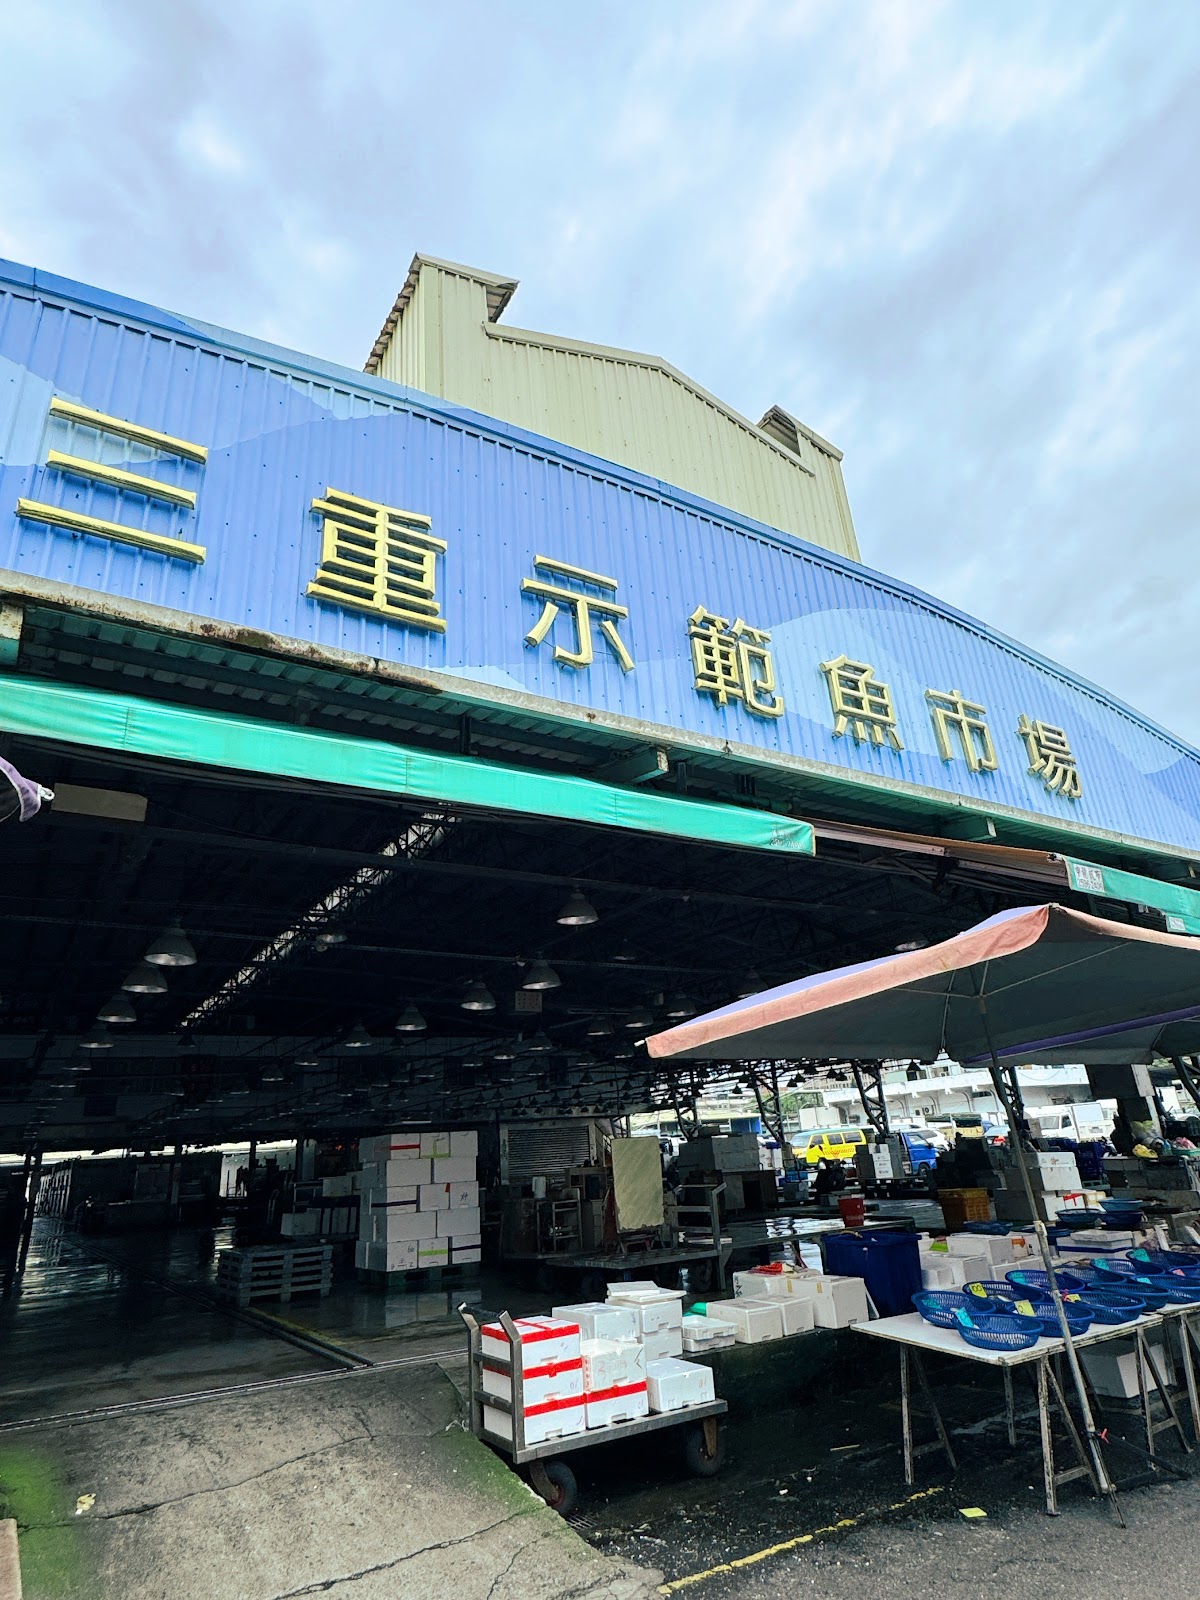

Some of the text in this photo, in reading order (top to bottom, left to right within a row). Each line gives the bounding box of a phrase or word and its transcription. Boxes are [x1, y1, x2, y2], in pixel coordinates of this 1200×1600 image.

[16, 396, 1082, 799] 三重示範魚市場
